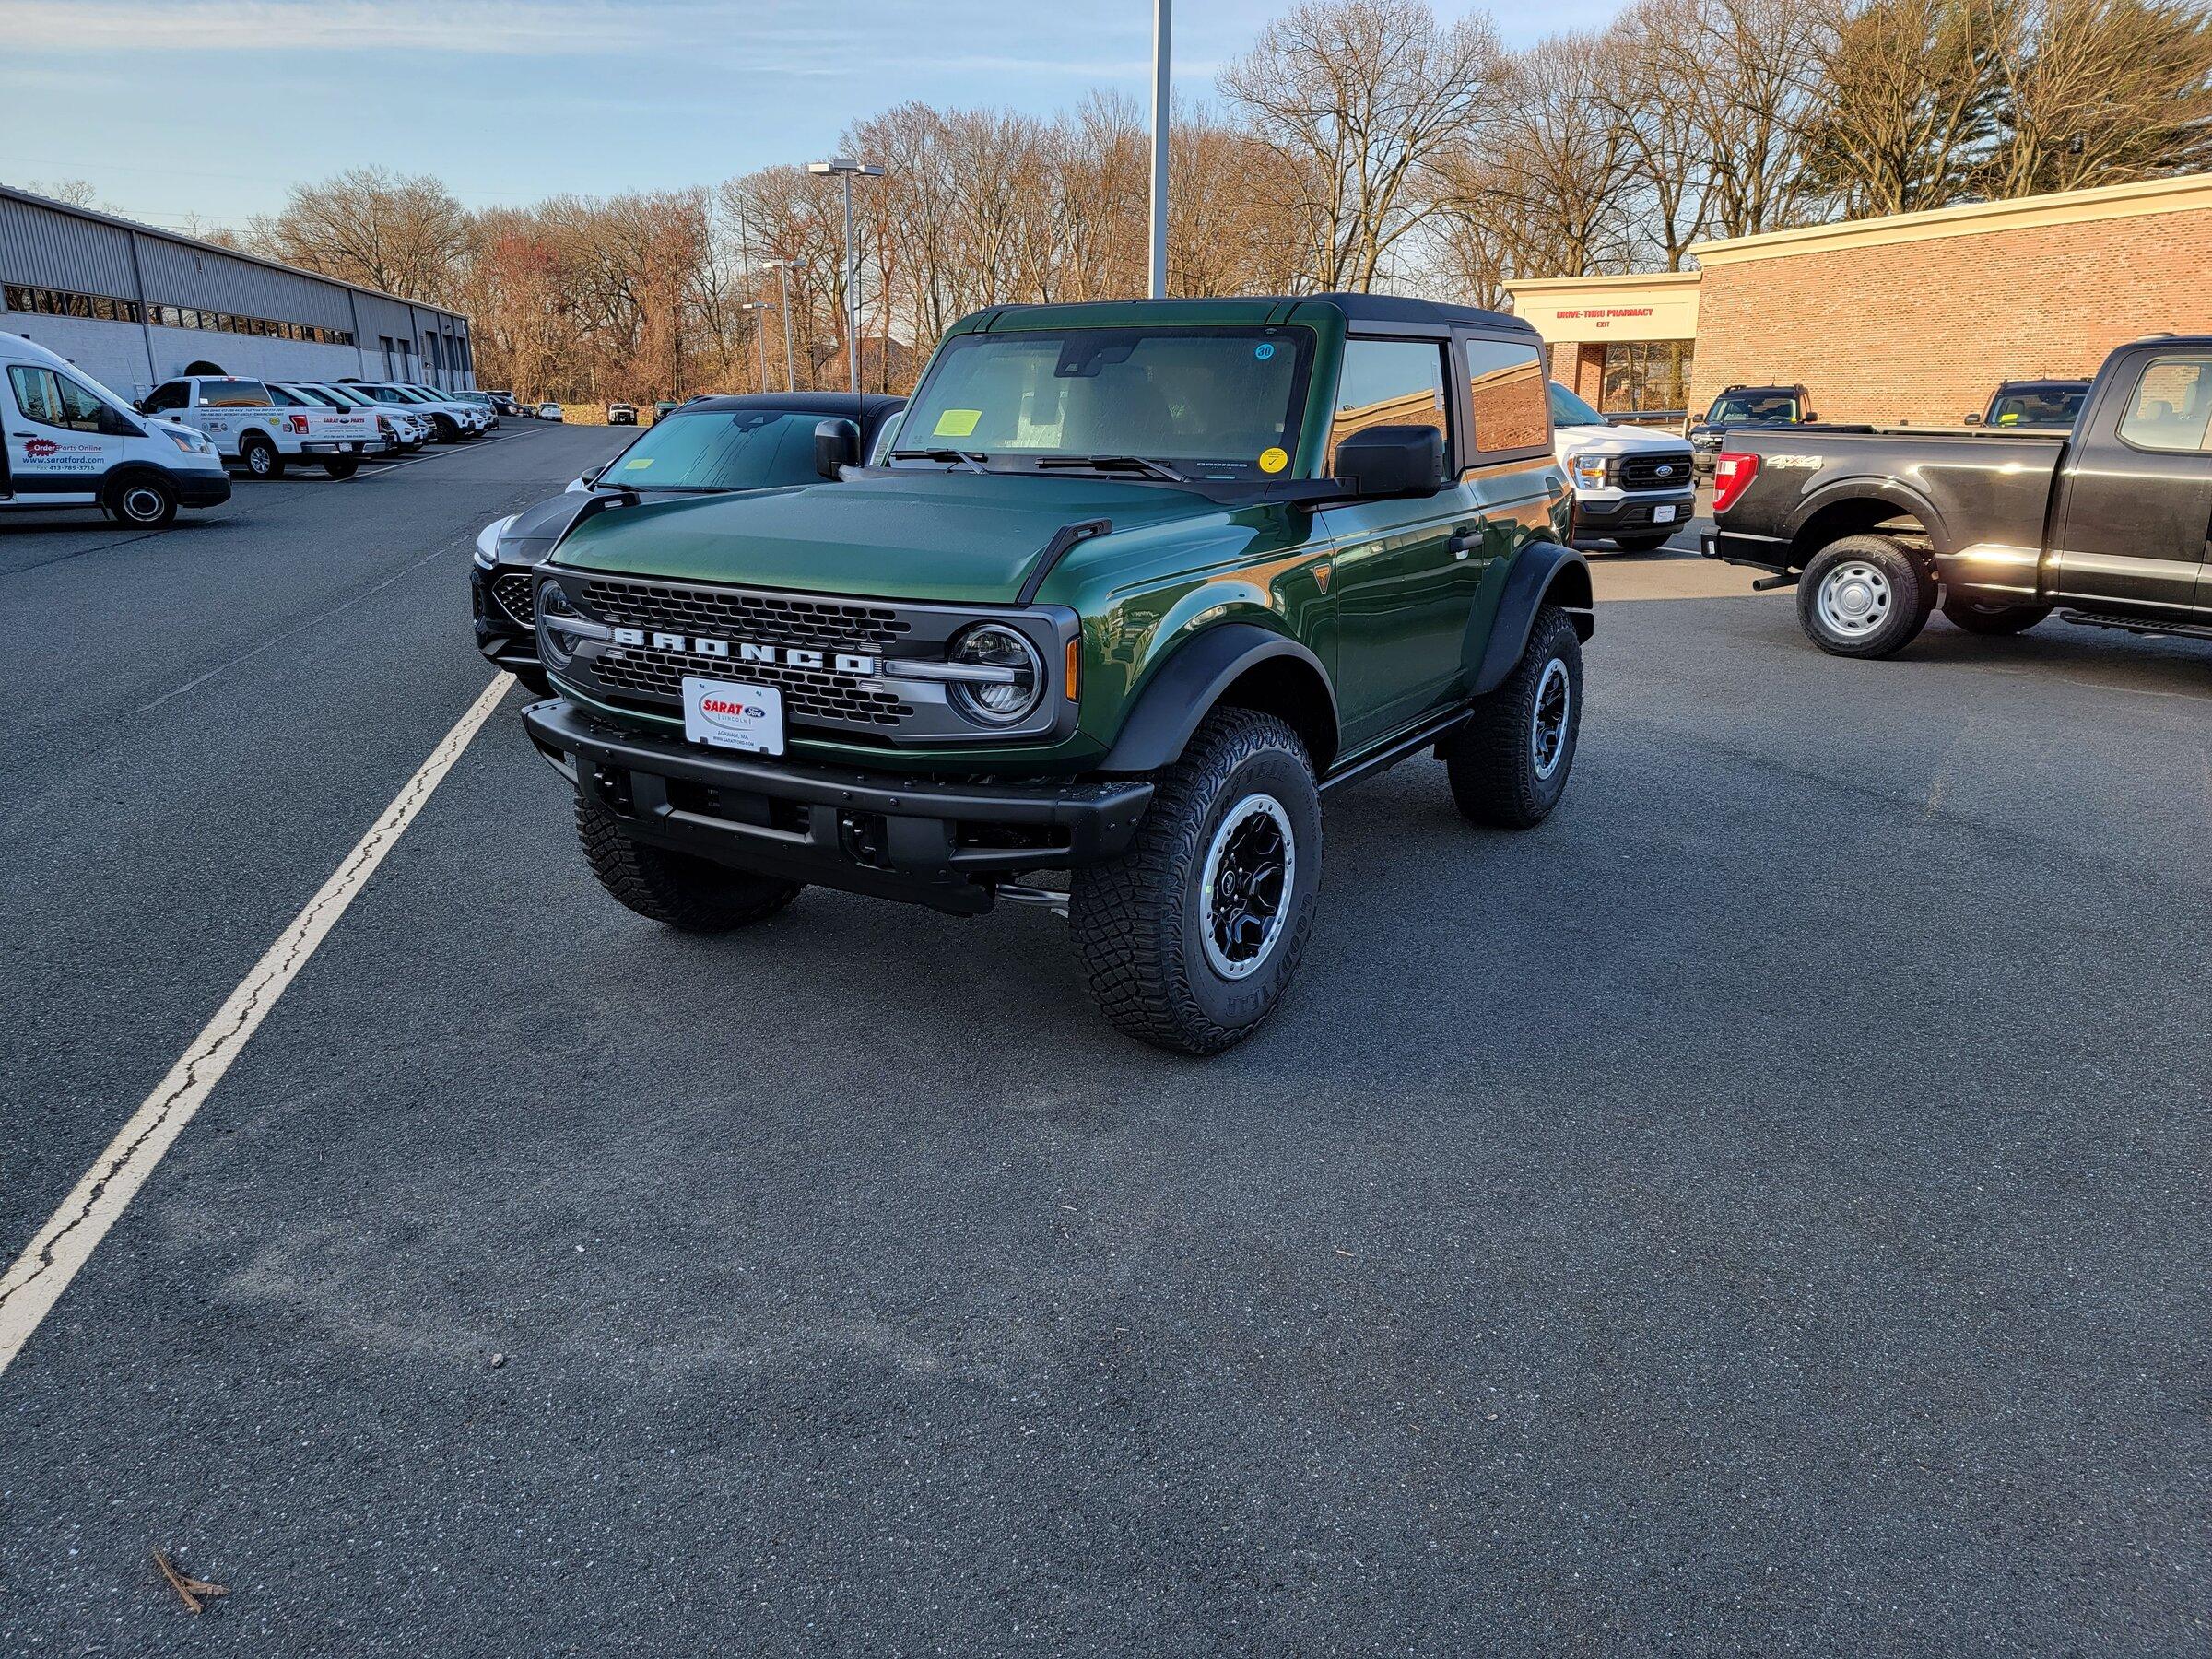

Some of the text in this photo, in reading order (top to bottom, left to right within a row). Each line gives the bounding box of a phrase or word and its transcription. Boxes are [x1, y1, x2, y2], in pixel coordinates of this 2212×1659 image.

[1556, 308, 1653, 319] DRIVE-THRU PHARMACY
[22, 455, 105, 464] www.saratford.com
[614, 627, 874, 675] BRONCO
[702, 700, 744, 715] SARAT
[722, 715, 748, 724] LINCOLN
